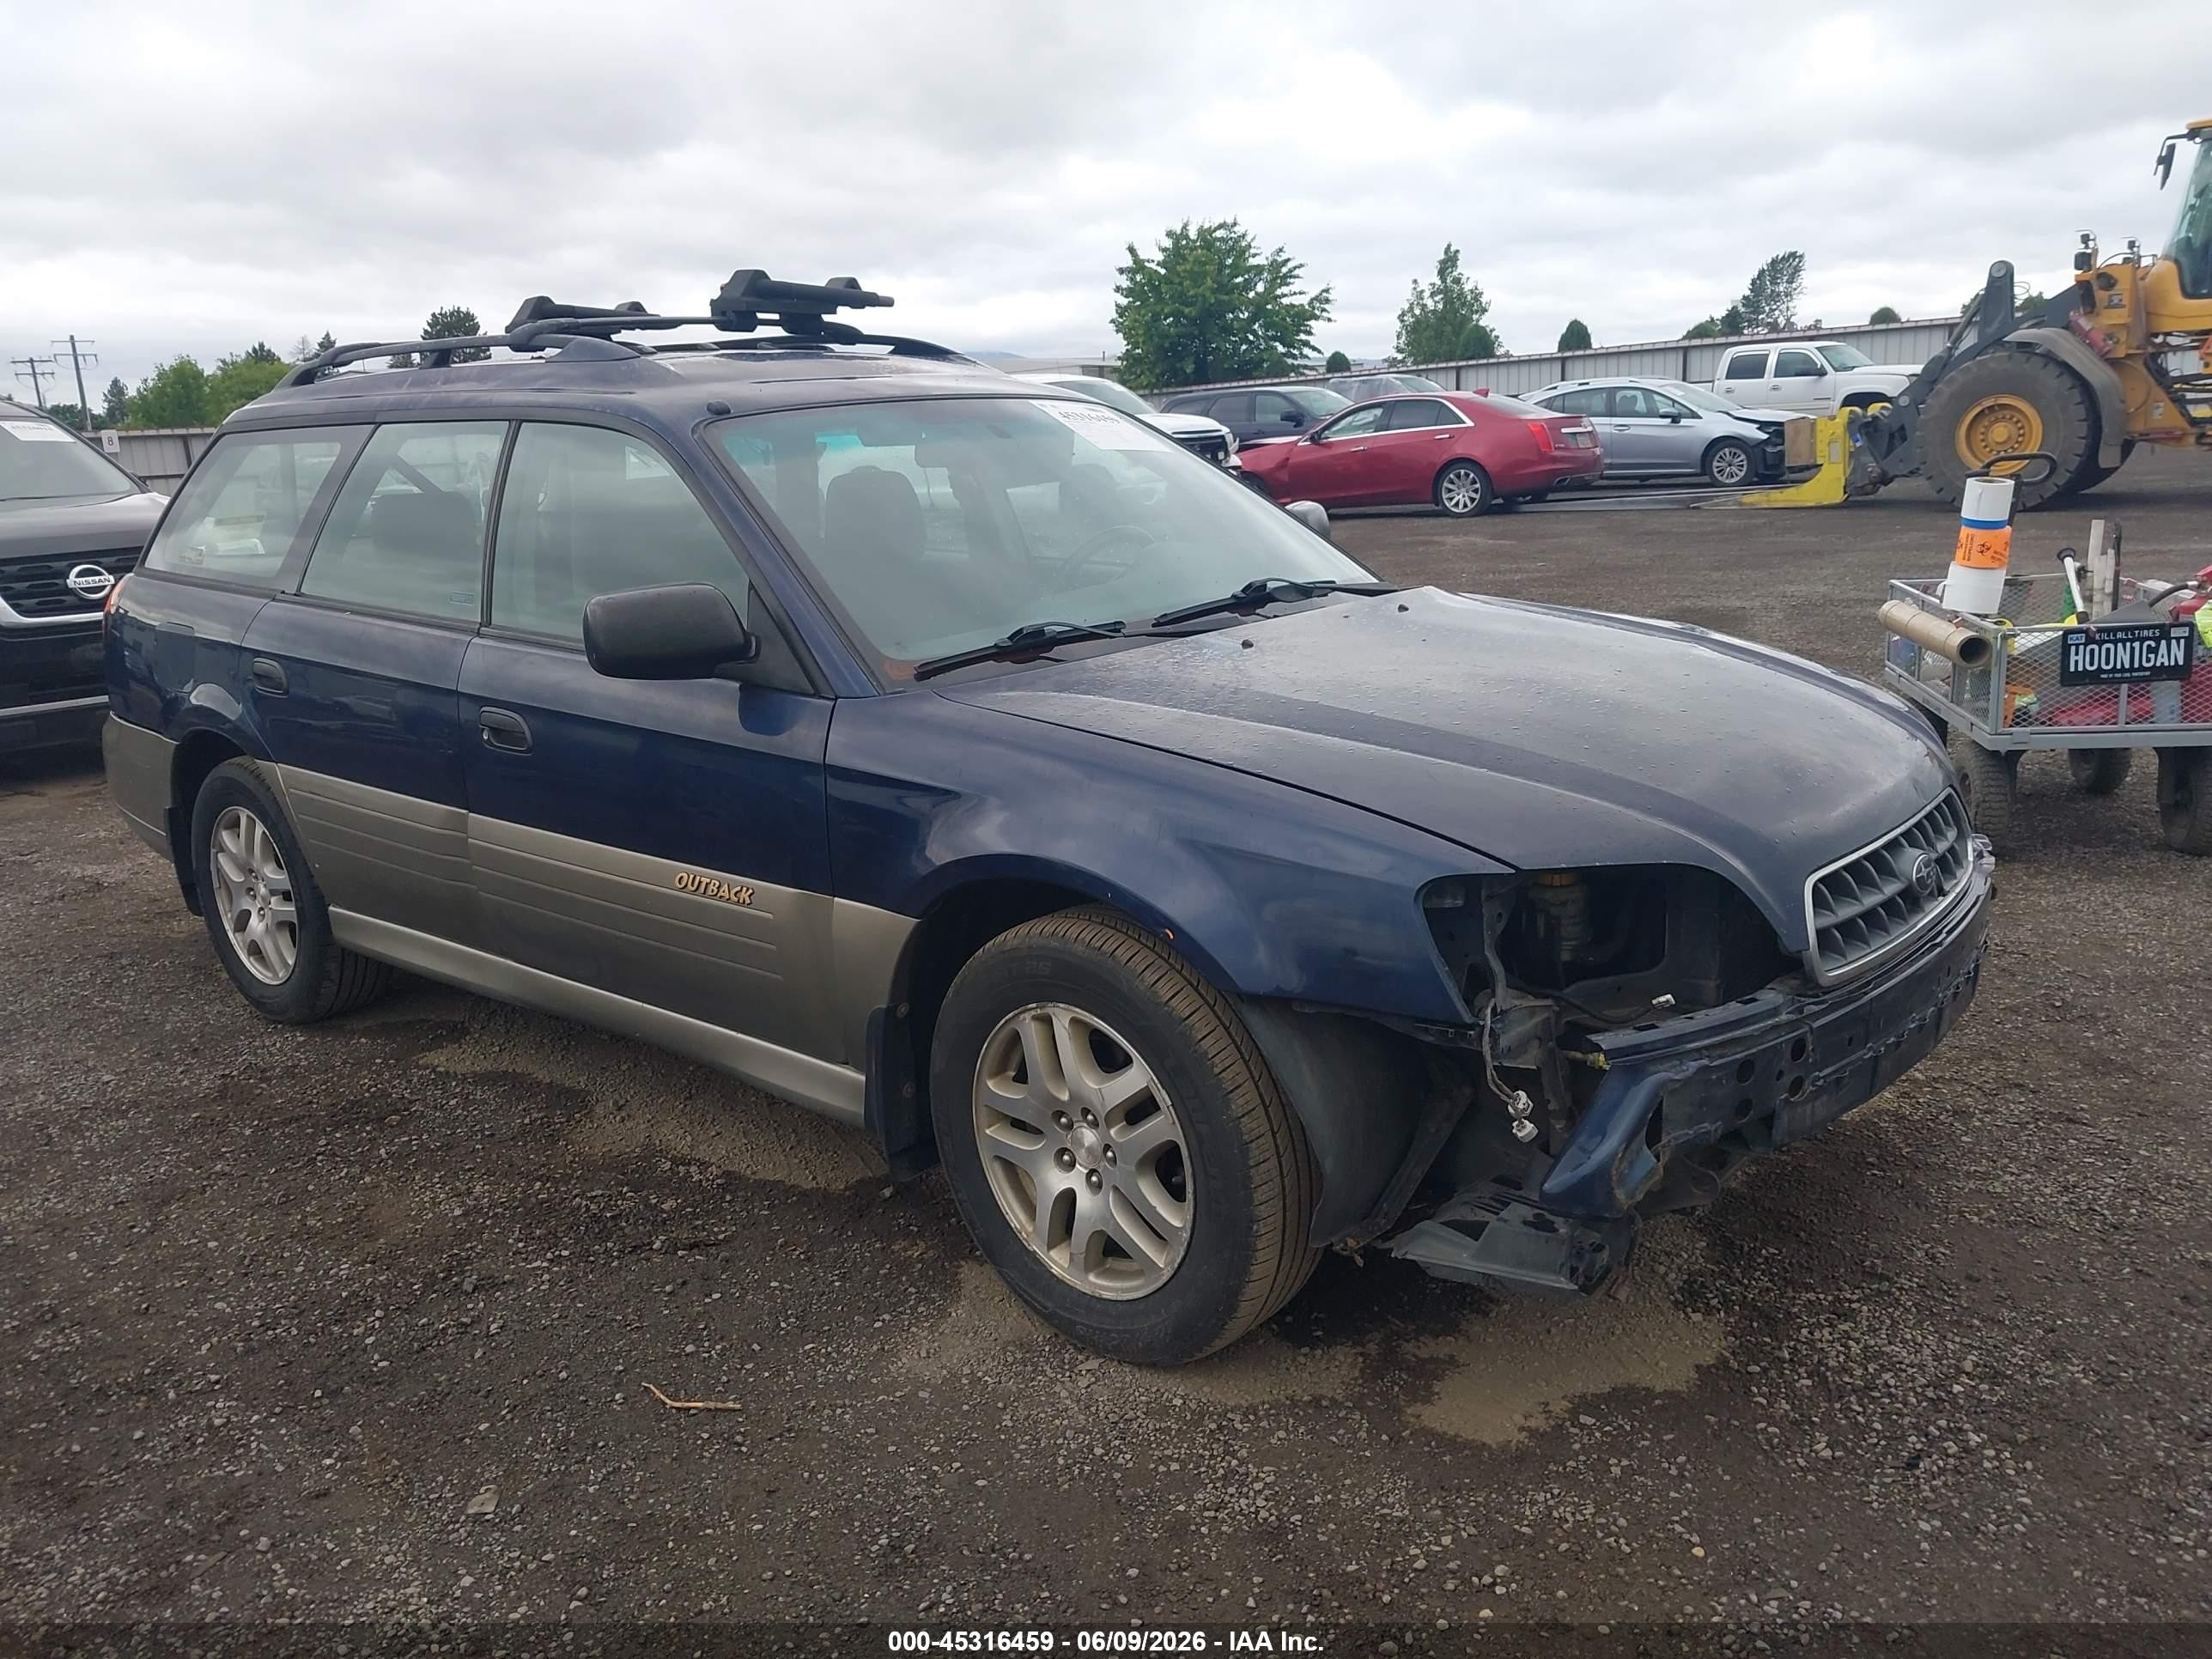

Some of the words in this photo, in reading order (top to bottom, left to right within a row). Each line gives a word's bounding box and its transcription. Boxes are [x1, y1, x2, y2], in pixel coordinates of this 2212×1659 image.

[73, 577, 111, 586] NISSAN
[2095, 631, 2115, 640] KILL
[2117, 630, 2133, 639] ALL
[2134, 629, 2160, 638] TIRES
[2069, 639, 2185, 672] HOON1GAN
[674, 871, 756, 906] OUTBACK
